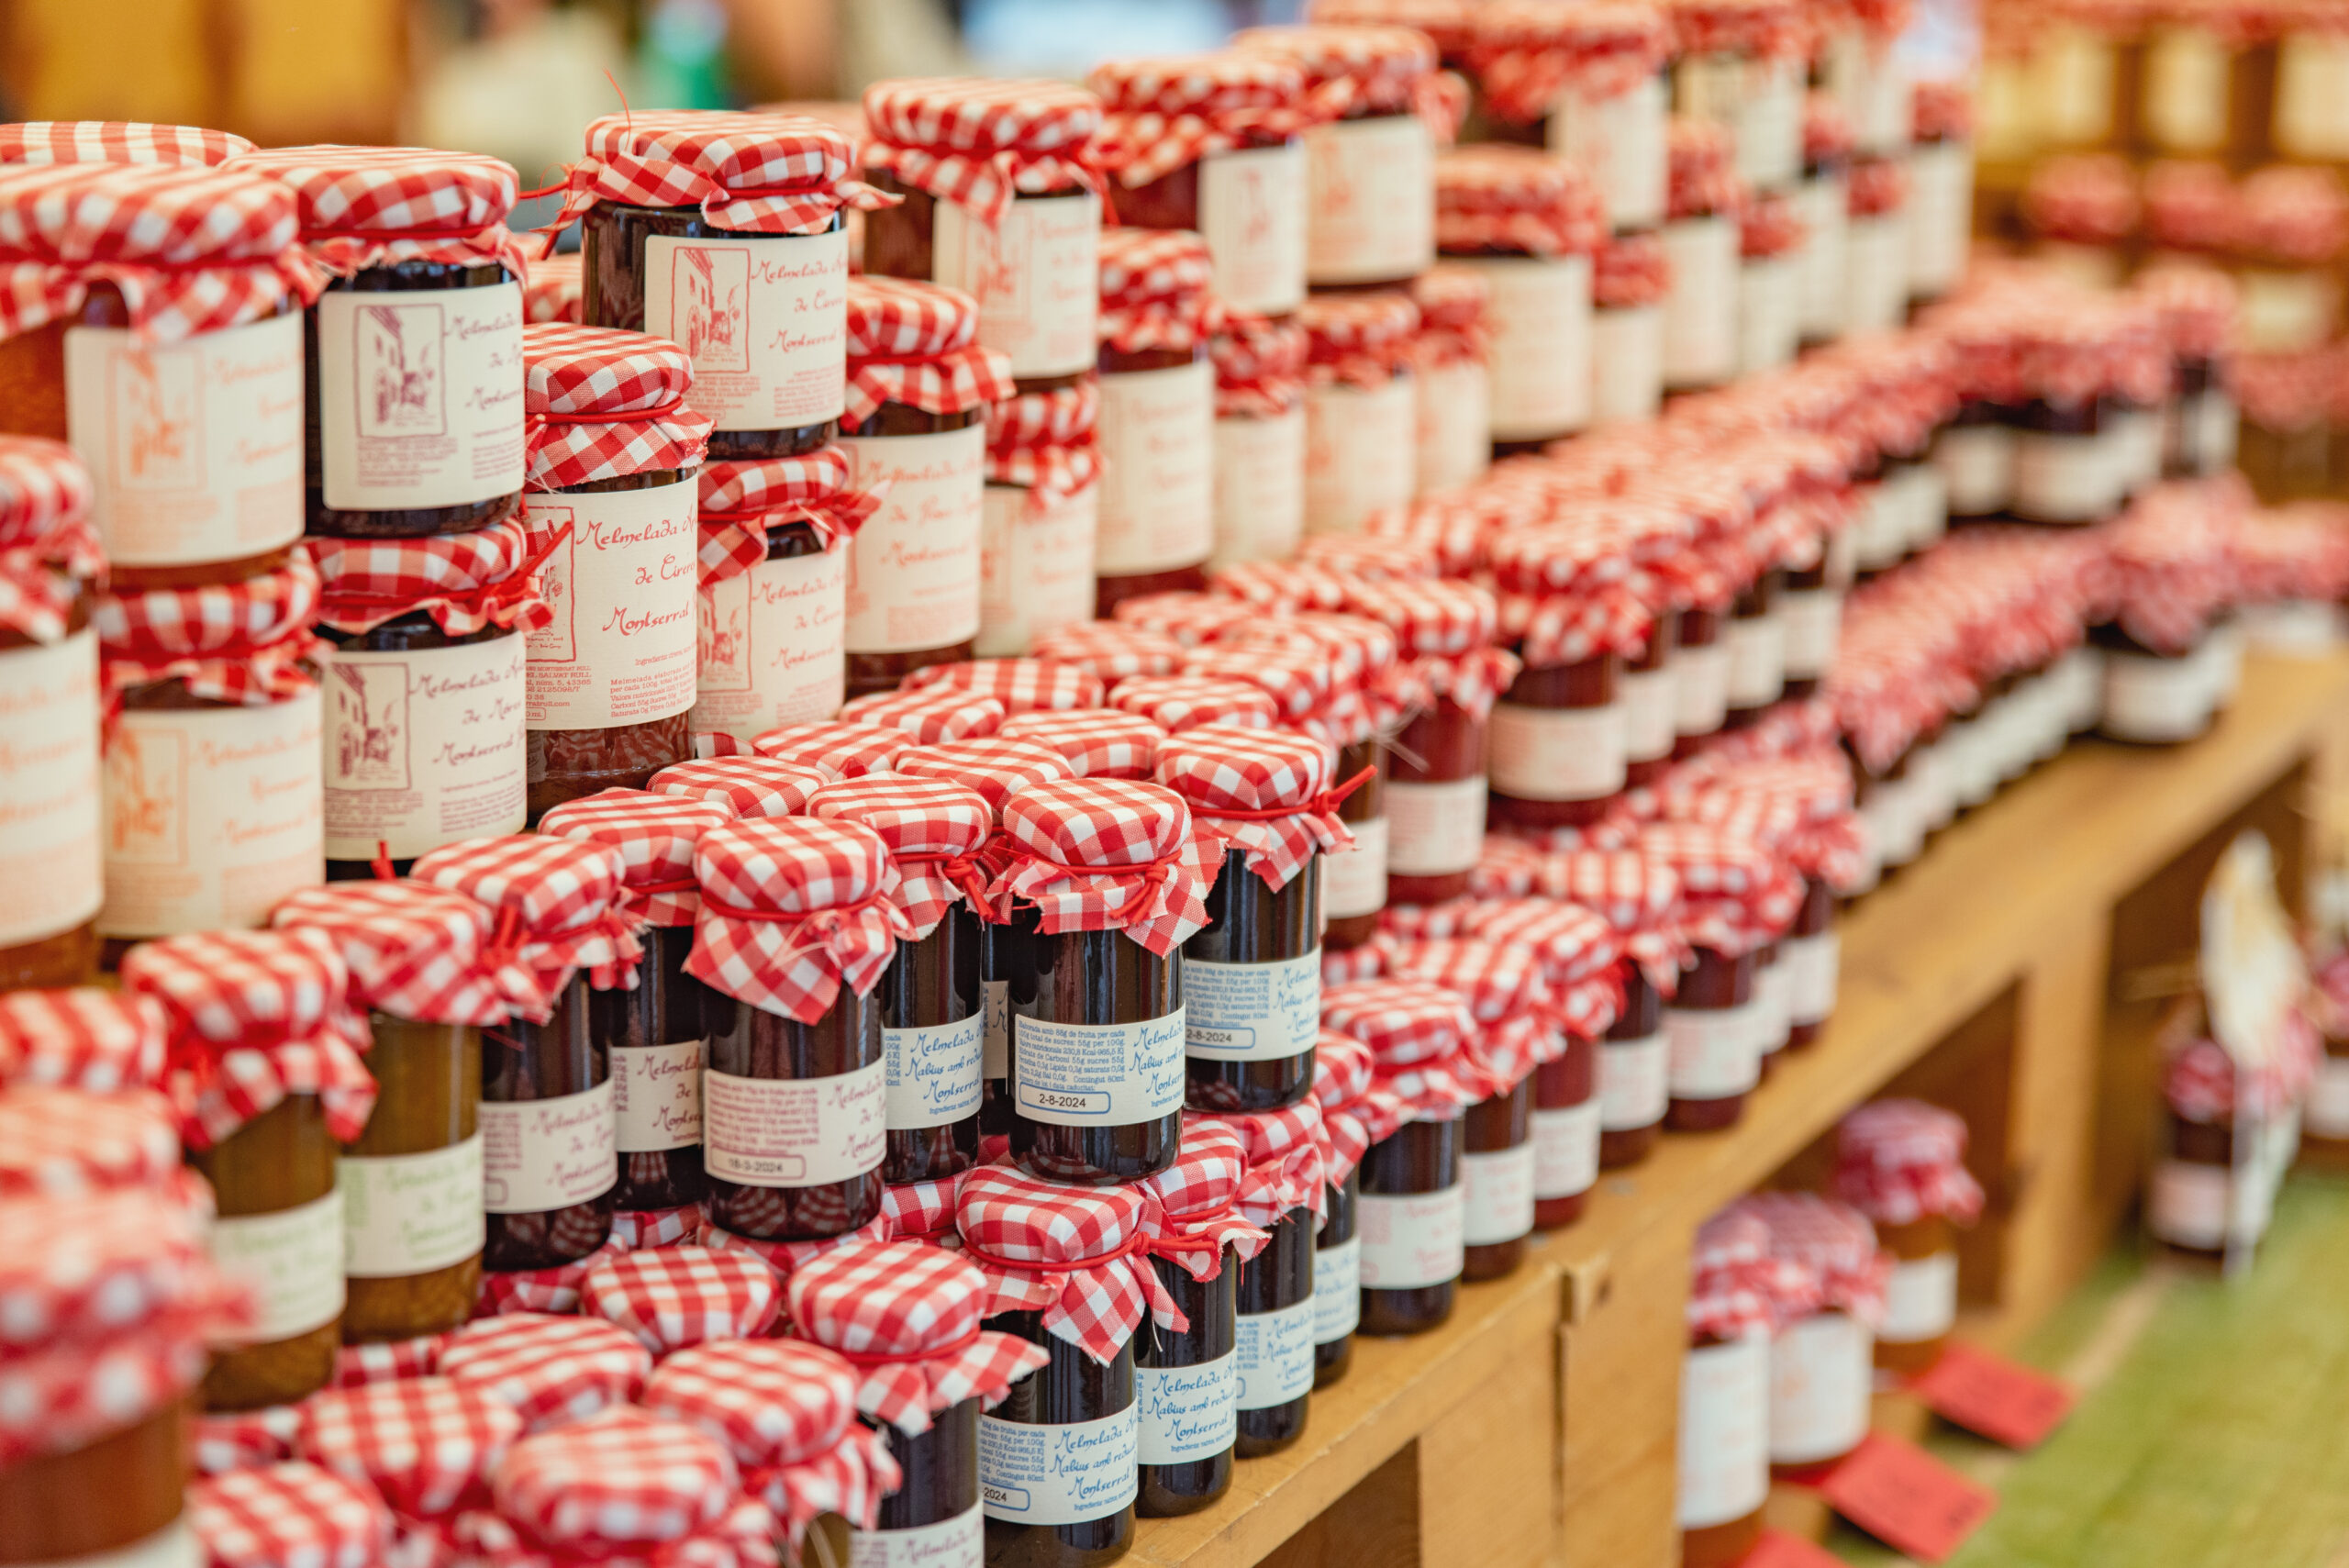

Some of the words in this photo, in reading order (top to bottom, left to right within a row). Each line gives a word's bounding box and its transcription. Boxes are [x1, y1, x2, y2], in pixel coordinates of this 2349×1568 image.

[575, 518, 678, 551] Melmelada
[634, 565, 653, 586] de
[910, 1029, 975, 1058] Melmelada
[1186, 1029, 1232, 1044] 2-8-2024
[1039, 1093, 1086, 1108] 2-8-2024
[1054, 1424, 1122, 1454] Melmelada
